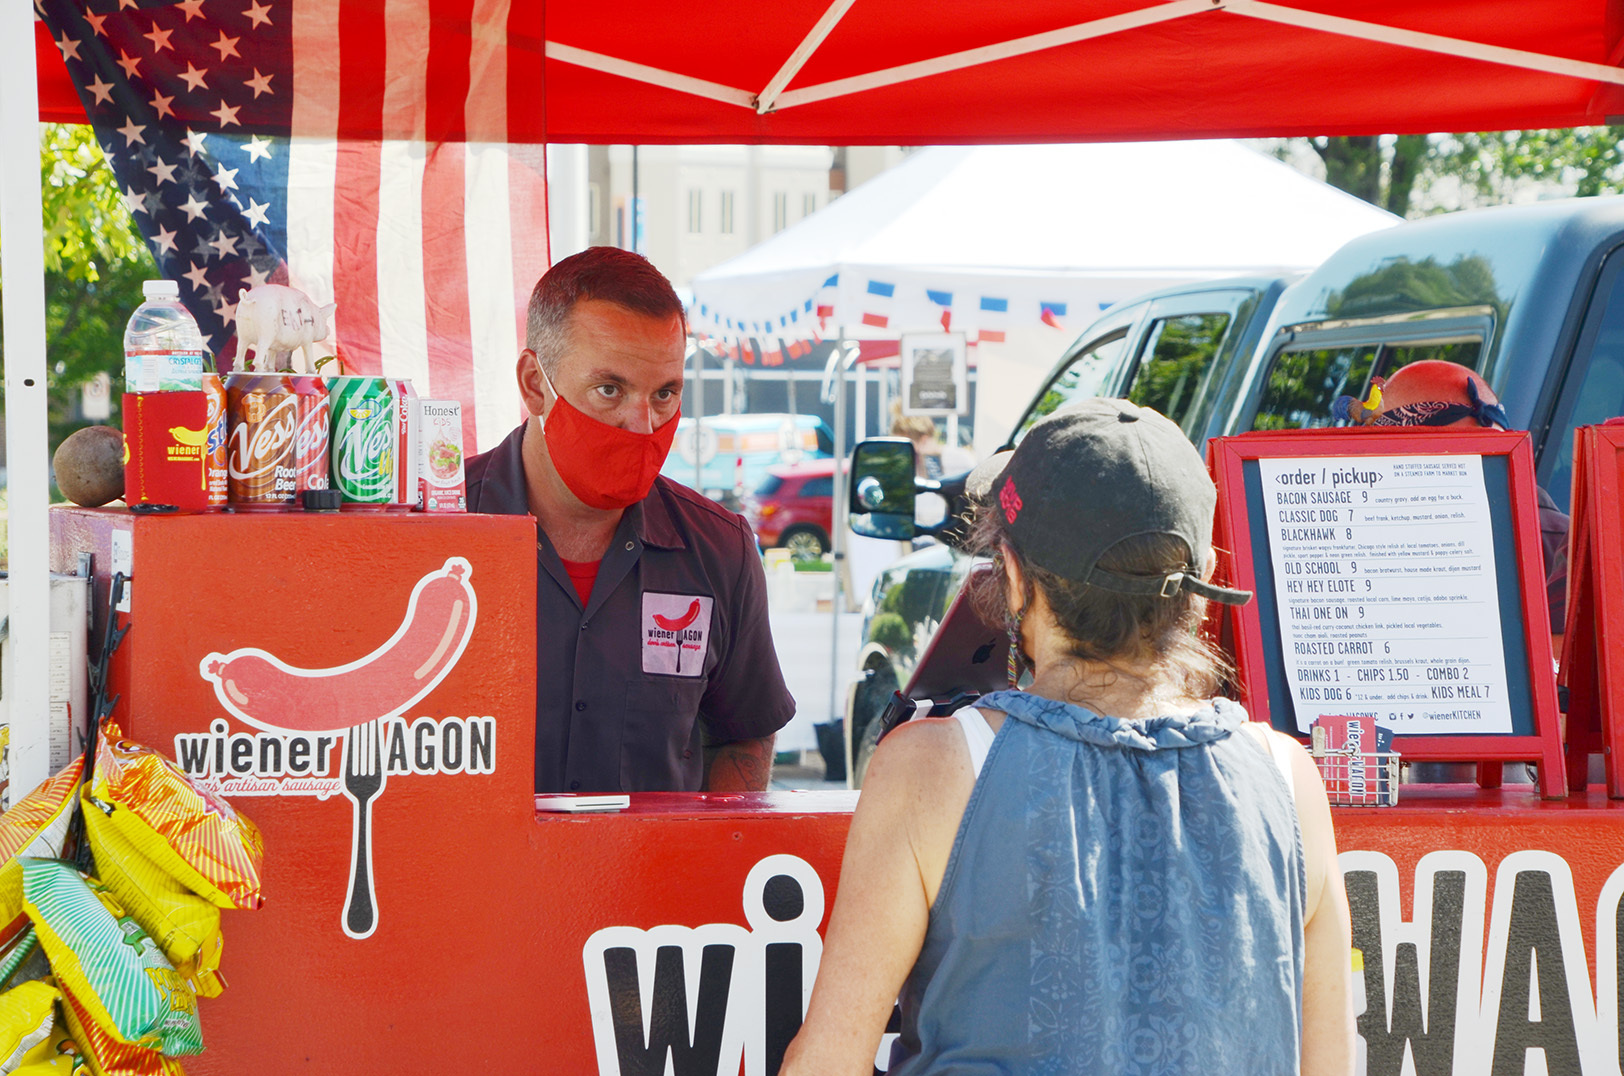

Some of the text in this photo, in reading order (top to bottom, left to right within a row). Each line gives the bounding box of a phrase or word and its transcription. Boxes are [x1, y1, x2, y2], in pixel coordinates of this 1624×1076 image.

[399, 396, 409, 422] Coke
[424, 405, 456, 417] Honest
[228, 403, 296, 473] Vess
[167, 444, 200, 455] wiener
[274, 465, 296, 478] Root
[1275, 468, 1384, 488] <order / pickup>
[274, 478, 296, 491] Beer
[1277, 491, 1368, 505] BACON SAUSAGE 9
[1279, 510, 1354, 523] CLASSIC DOG 7
[1281, 528, 1352, 541] BLACKHAWK 8
[1284, 561, 1357, 574] OLD SCHOOL 9
[1287, 579, 1372, 592] HEY HEY ELOTE 9
[1290, 606, 1364, 620] THAI ONE ON 9
[648, 627, 675, 639] wiener
[1294, 642, 1390, 655] ROASTED CARROT 6
[1298, 669, 1332, 682] DRINKS
[1334, 668, 1340, 682] 1
[1358, 668, 1385, 681] CHIPS
[1388, 668, 1408, 680] 1.50
[1426, 668, 1460, 680] COMBO
[1463, 667, 1469, 680] 2
[1300, 688, 1352, 700] KIDS DOG 6
[1431, 686, 1490, 698] KIDS MEAL 7
[179, 723, 332, 774] wiener
[224, 777, 341, 796] artisan sausage
